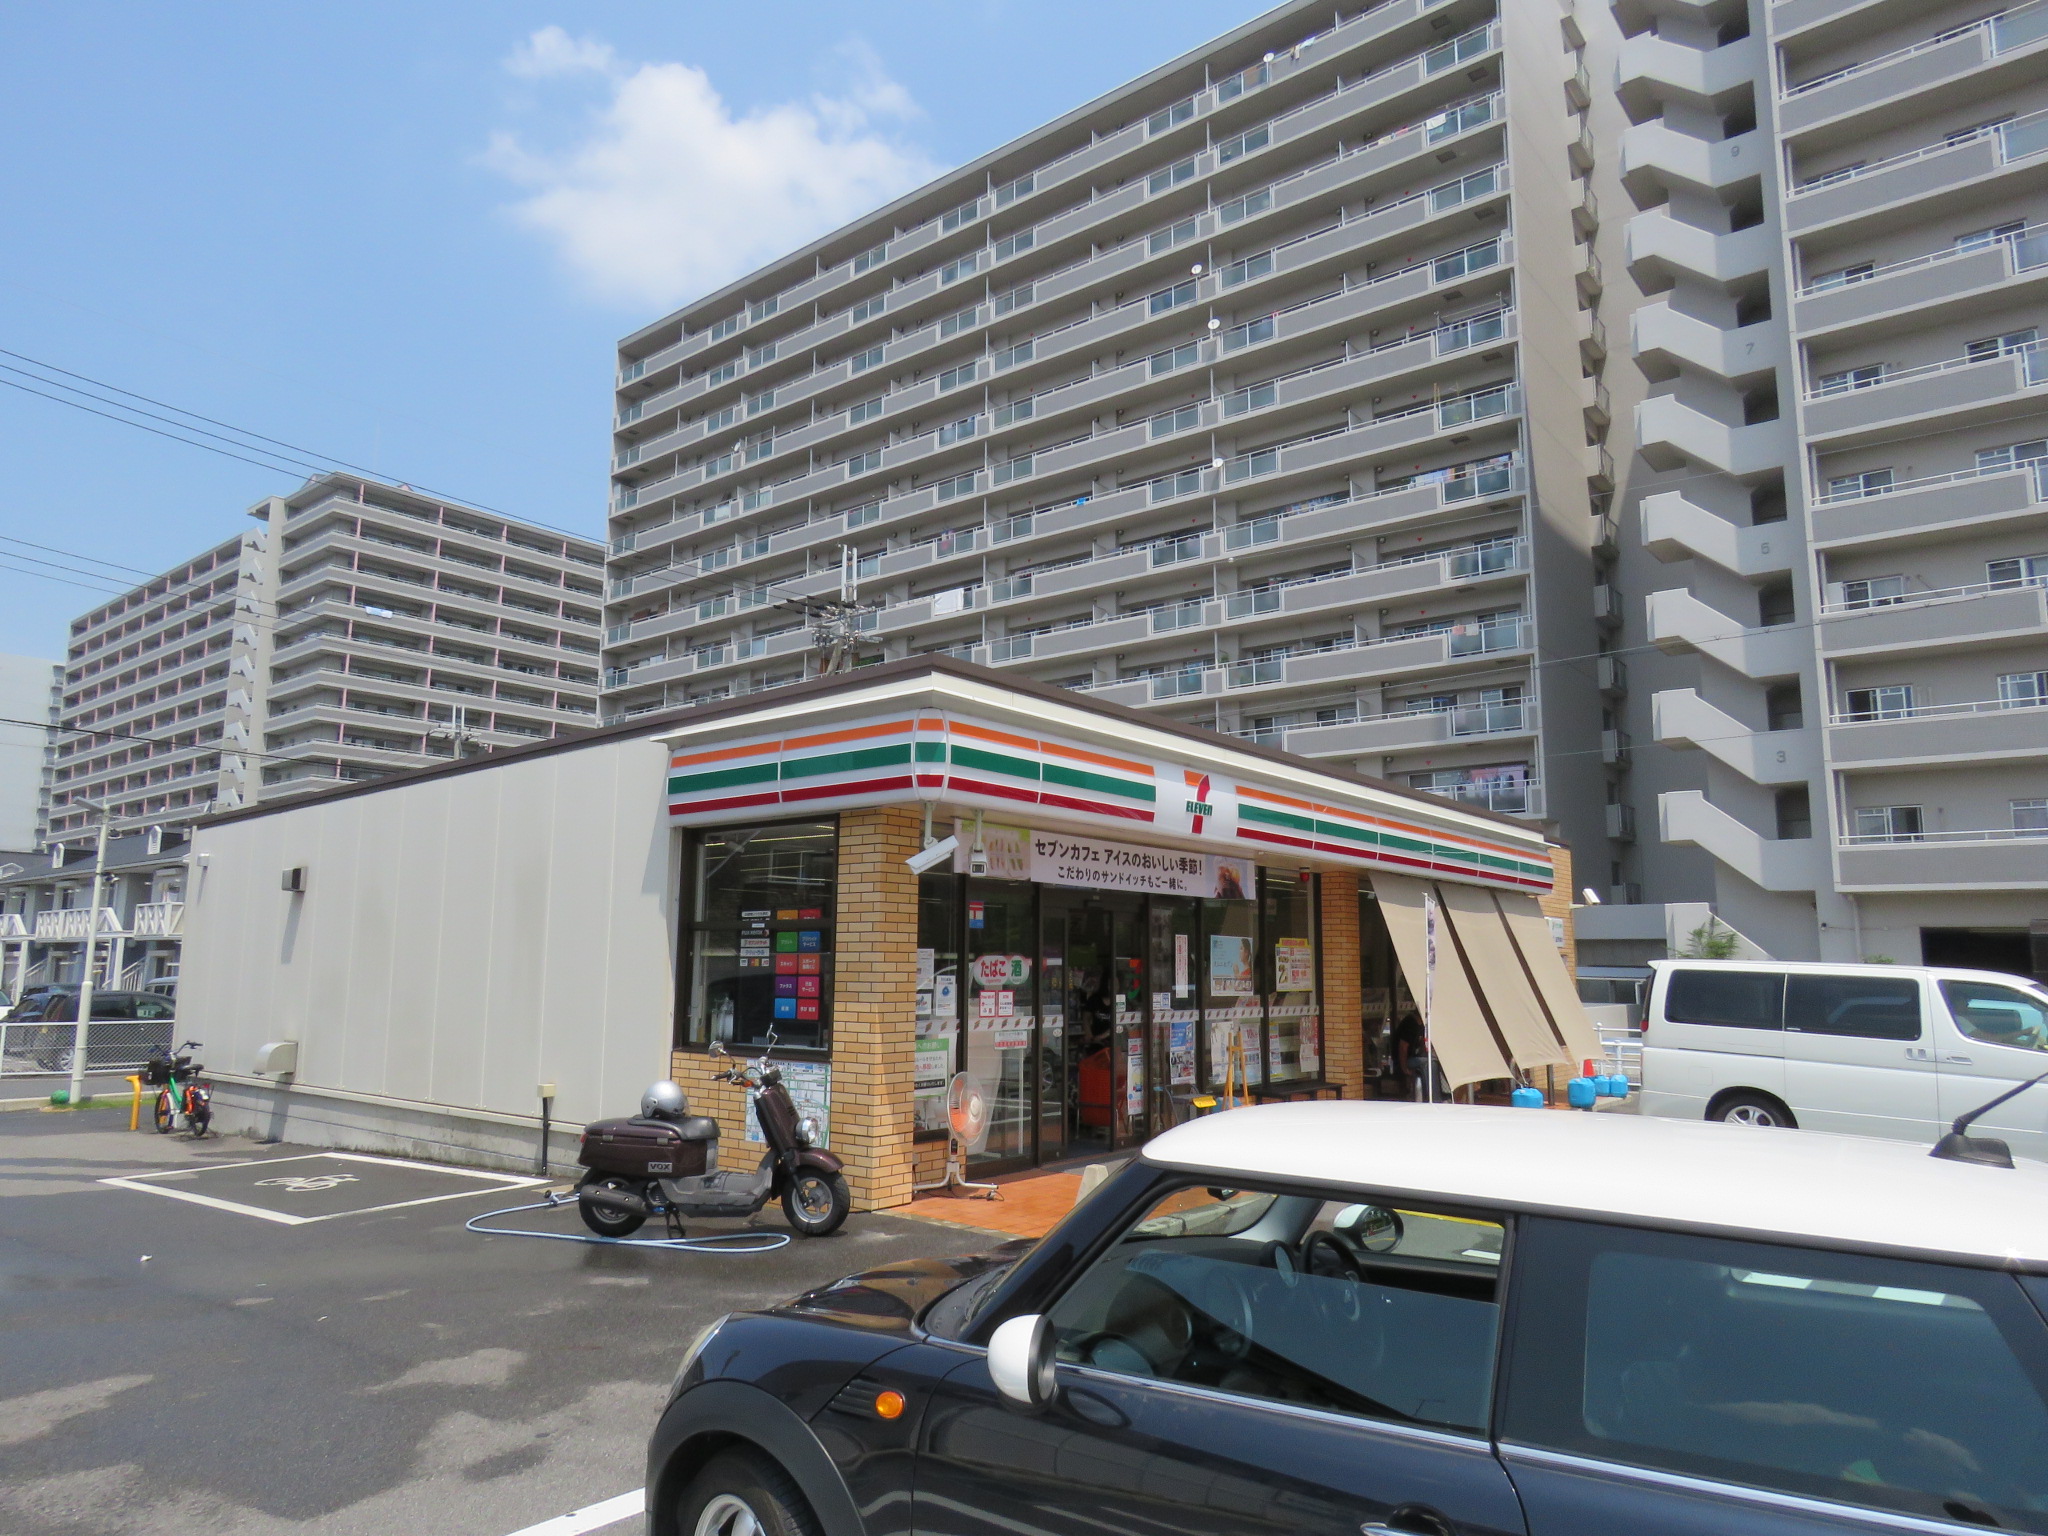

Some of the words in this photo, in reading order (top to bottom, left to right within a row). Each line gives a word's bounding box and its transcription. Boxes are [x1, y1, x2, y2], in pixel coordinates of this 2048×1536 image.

[1745, 342, 1756, 355] 7
[1776, 750, 1787, 763] 3
[1035, 838, 1100, 862] セブンカフェ
[1057, 865, 1188, 891] こだわりのサンドイッチもご一緒に。
[981, 959, 1007, 977] たばこ
[1011, 959, 1022, 977] 酒
